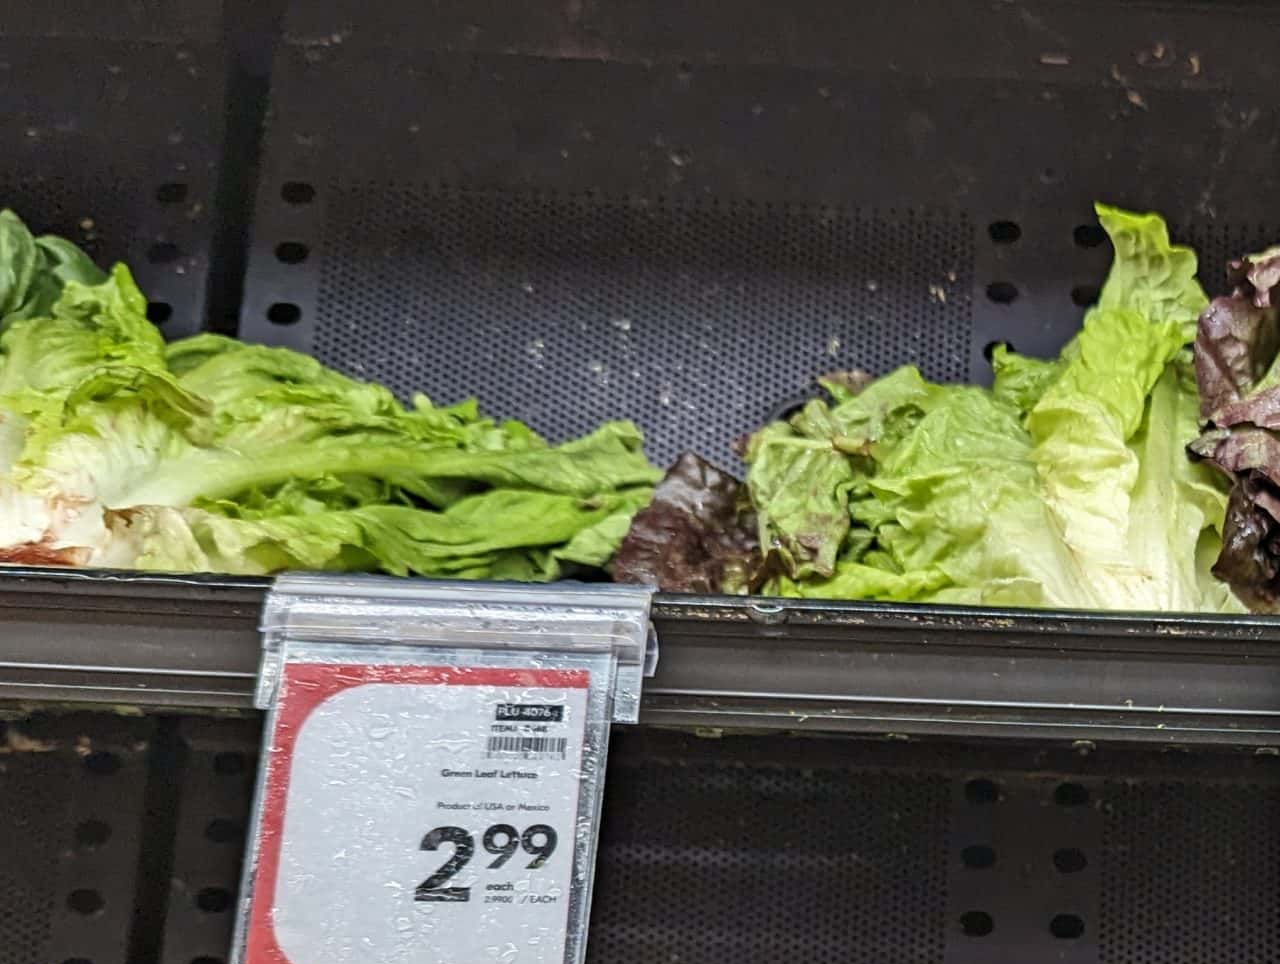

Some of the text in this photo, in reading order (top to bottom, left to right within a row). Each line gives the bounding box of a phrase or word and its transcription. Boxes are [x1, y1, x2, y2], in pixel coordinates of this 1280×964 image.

[441, 768, 539, 780] Green Leaf Lettuce
[437, 801, 470, 810] Product
[484, 801, 504, 811] USA
[505, 803, 516, 811] or
[518, 803, 551, 812] Mexico
[485, 881, 514, 891] each
[529, 895, 557, 904] EACH
